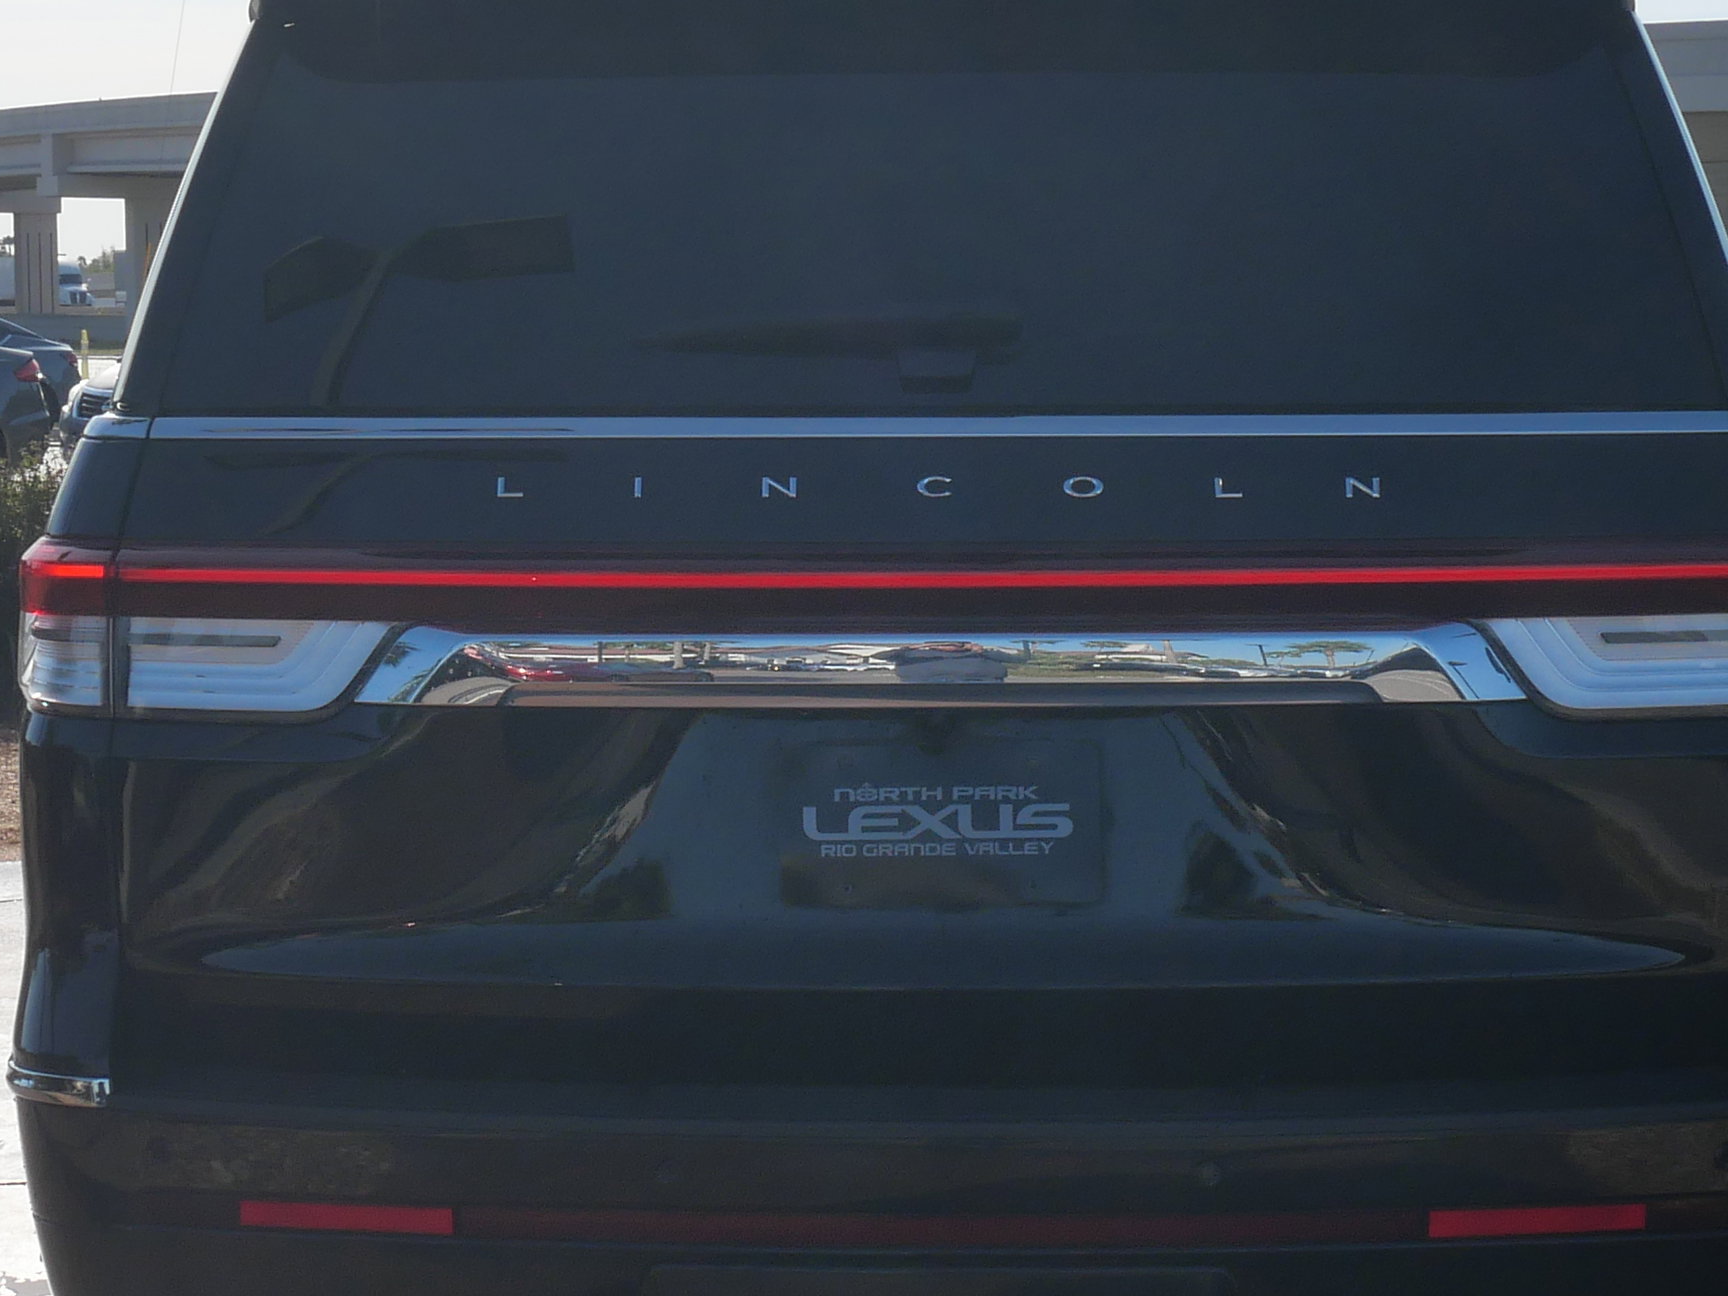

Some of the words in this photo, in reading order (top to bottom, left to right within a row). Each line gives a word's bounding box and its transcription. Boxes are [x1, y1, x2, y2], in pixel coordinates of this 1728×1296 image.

[496, 474, 1382, 498] LINCOLN
[833, 783, 942, 802] NORTH
[952, 786, 1039, 801] PARK
[802, 803, 1074, 841] LEXUS
[821, 844, 857, 857] RIO
[862, 843, 957, 856] GRANDE
[964, 841, 1054, 856] VALLEY
